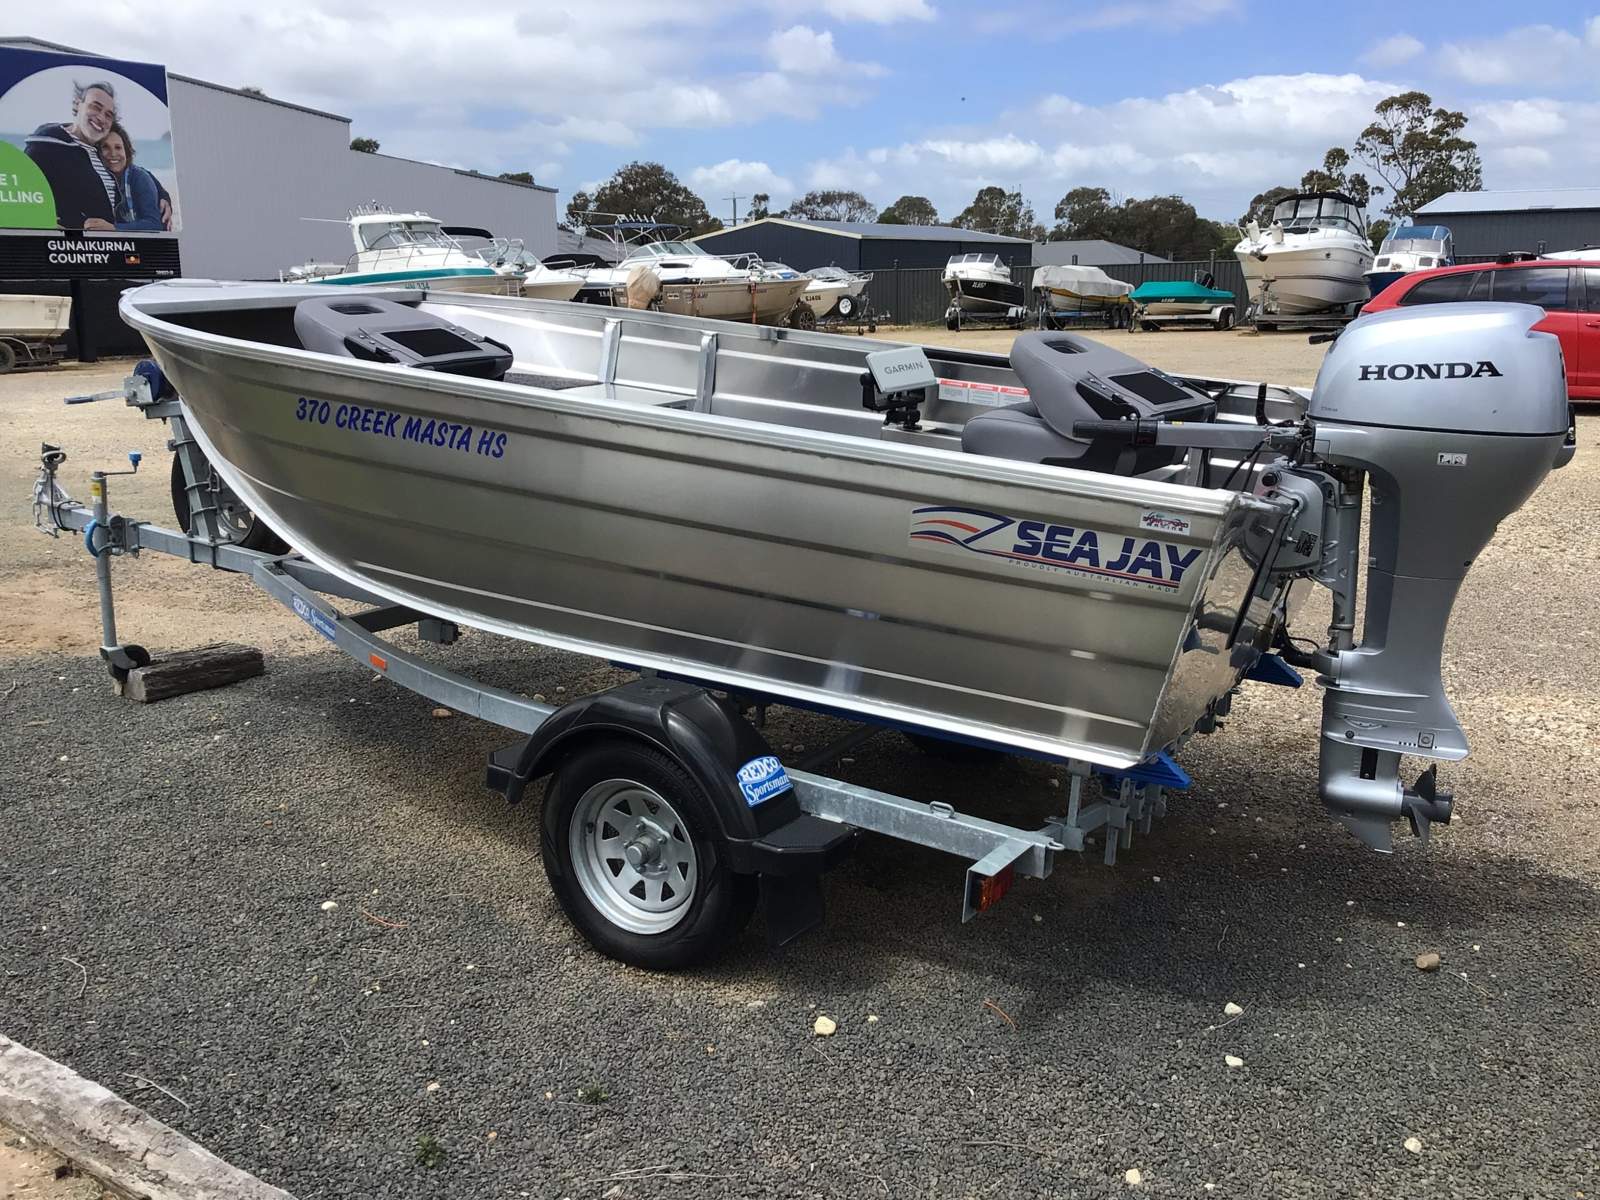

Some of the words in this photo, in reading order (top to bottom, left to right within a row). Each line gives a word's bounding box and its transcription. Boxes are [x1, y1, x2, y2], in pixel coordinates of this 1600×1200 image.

[11, 174, 18, 186] 1
[0, 190, 44, 204] LLING
[47, 240, 136, 252] GUNAIKURNAI
[48, 253, 109, 264] COUNTRY
[884, 361, 925, 376] GARMIN
[1358, 361, 1503, 381] HONDA
[296, 397, 331, 425] 370
[335, 404, 401, 438] CREEK
[402, 416, 473, 453] MASTA
[477, 429, 508, 458] HS
[1012, 520, 1101, 568] SEA
[1105, 537, 1203, 581] JAY
[1008, 559, 1059, 573] PROUDLY
[1066, 570, 1139, 586] AUSTRALIAN
[1147, 585, 1180, 594] MADE
[741, 757, 778, 781] REDCO
[745, 774, 790, 801] Sportsman
